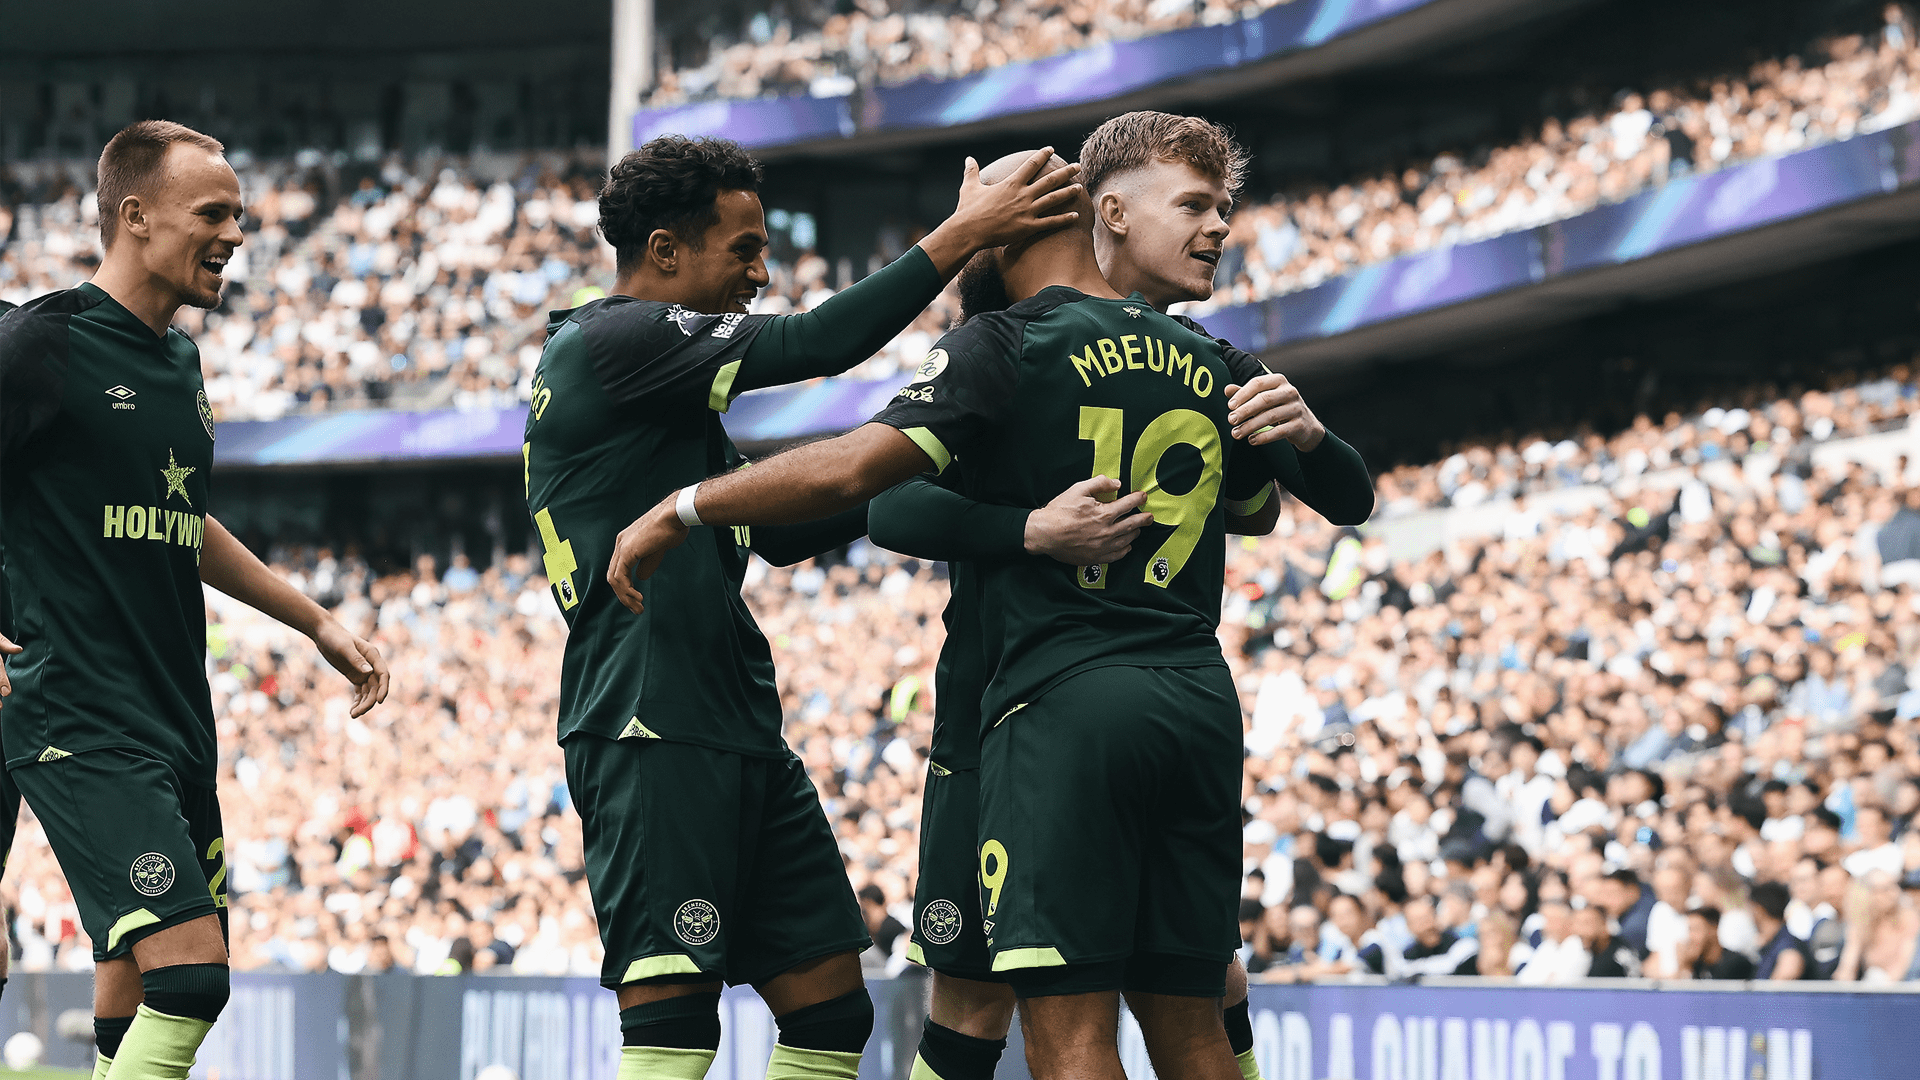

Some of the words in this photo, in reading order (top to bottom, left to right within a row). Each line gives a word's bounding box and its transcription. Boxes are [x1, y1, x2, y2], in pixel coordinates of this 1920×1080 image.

[1069, 334, 1214, 398] MBEUMO
[112, 401, 136, 411] umbro
[1077, 405, 1223, 590] 19
[103, 504, 205, 550] HOLYWO
[681, 902, 713, 913] BRENTFORD
[1250, 1008, 1313, 1080] OR
[1681, 1024, 1813, 1080] WN
